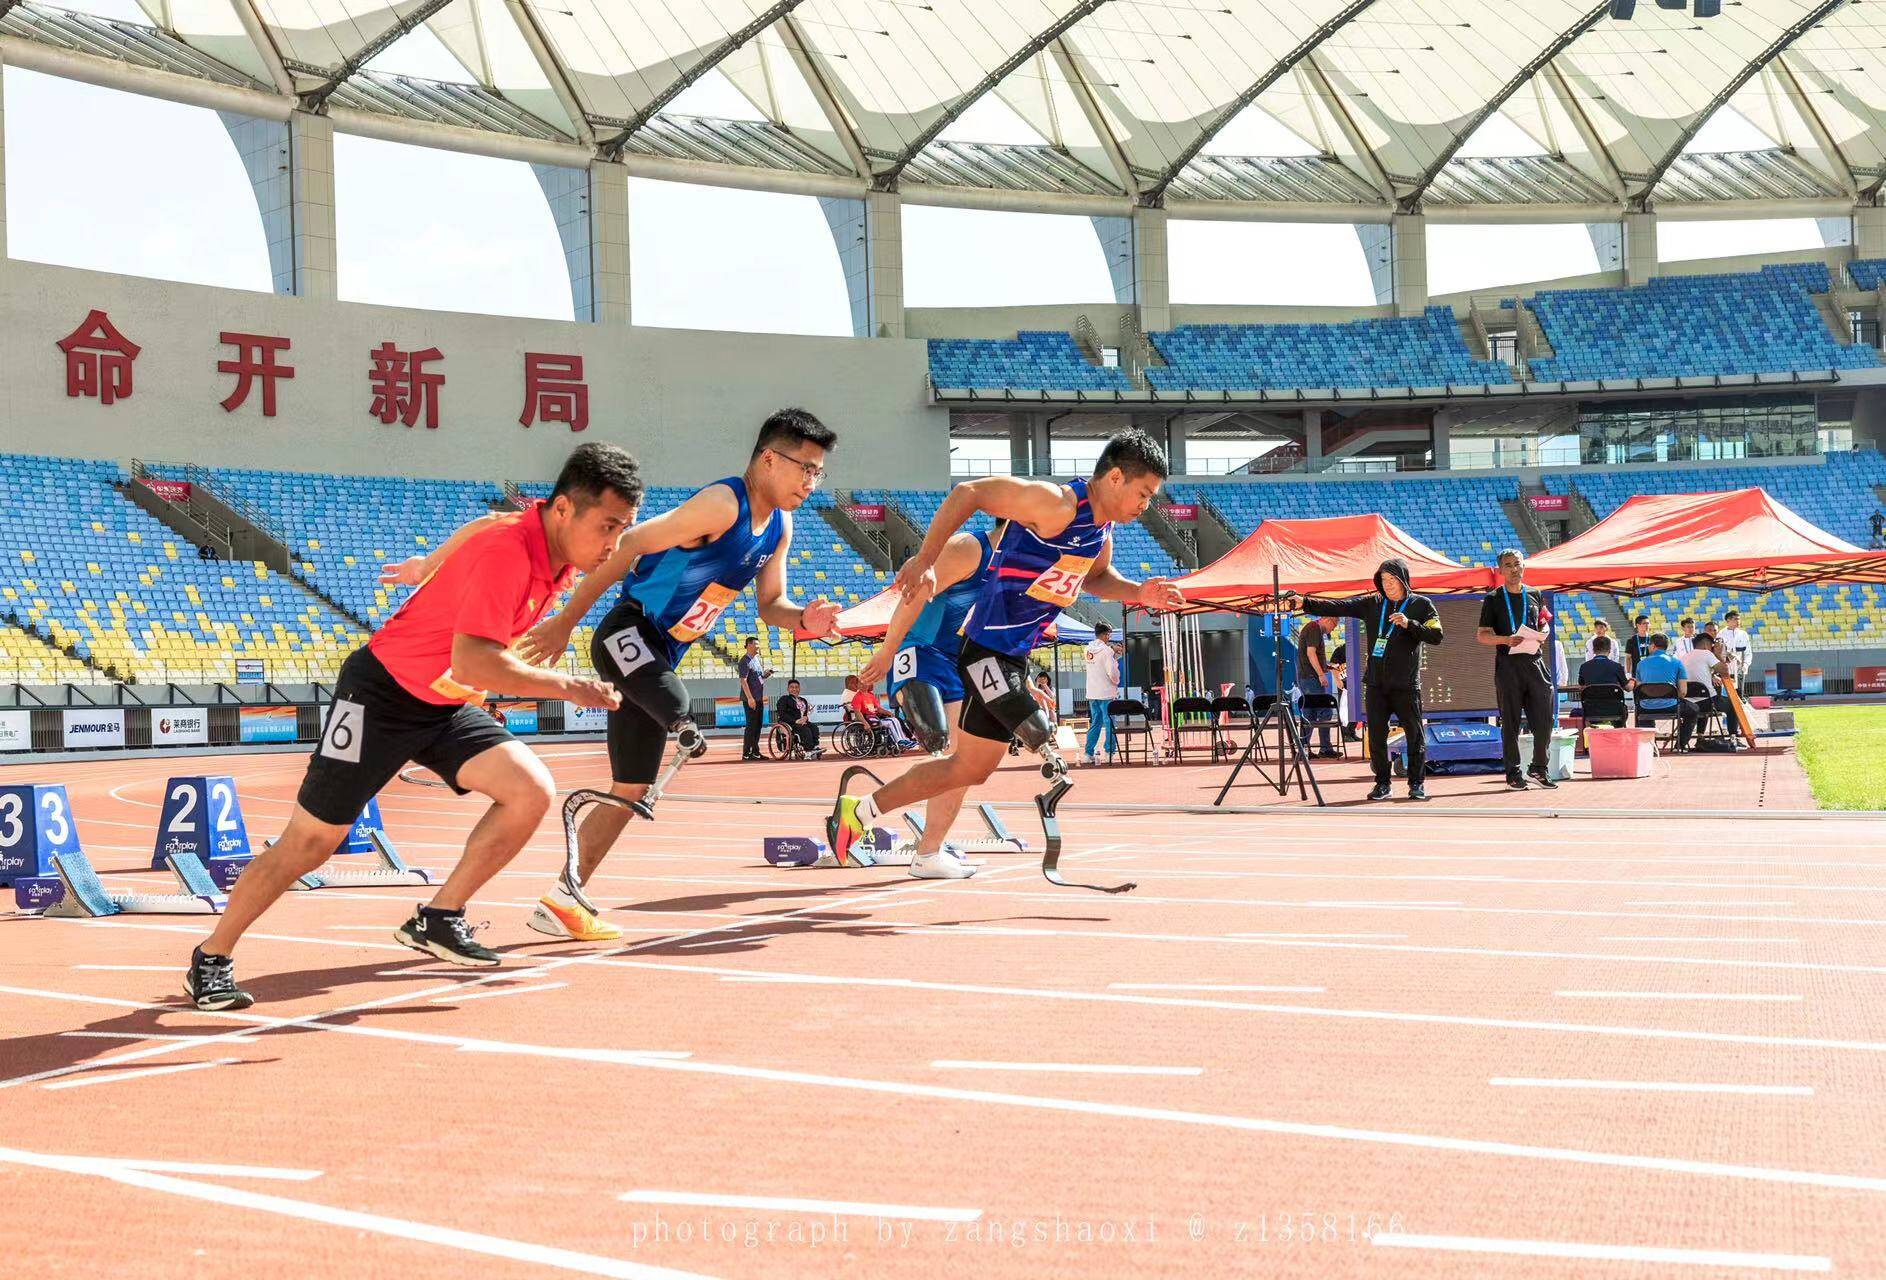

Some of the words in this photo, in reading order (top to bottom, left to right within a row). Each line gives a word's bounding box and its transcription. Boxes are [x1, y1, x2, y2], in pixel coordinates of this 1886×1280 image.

[57, 309, 589, 431] 命开新局
[617, 634, 641, 663] 5
[898, 653, 911, 675] 3
[982, 665, 999, 691] 4
[69, 723, 106, 734] JENMOUR
[107, 722, 120, 732] 金马
[173, 719, 201, 729] 莱商银行
[331, 711, 352, 750] 6
[0, 793, 23, 847] 3
[41, 792, 69, 845] 3
[168, 784, 197, 832] 2
[212, 783, 238, 832] 2
